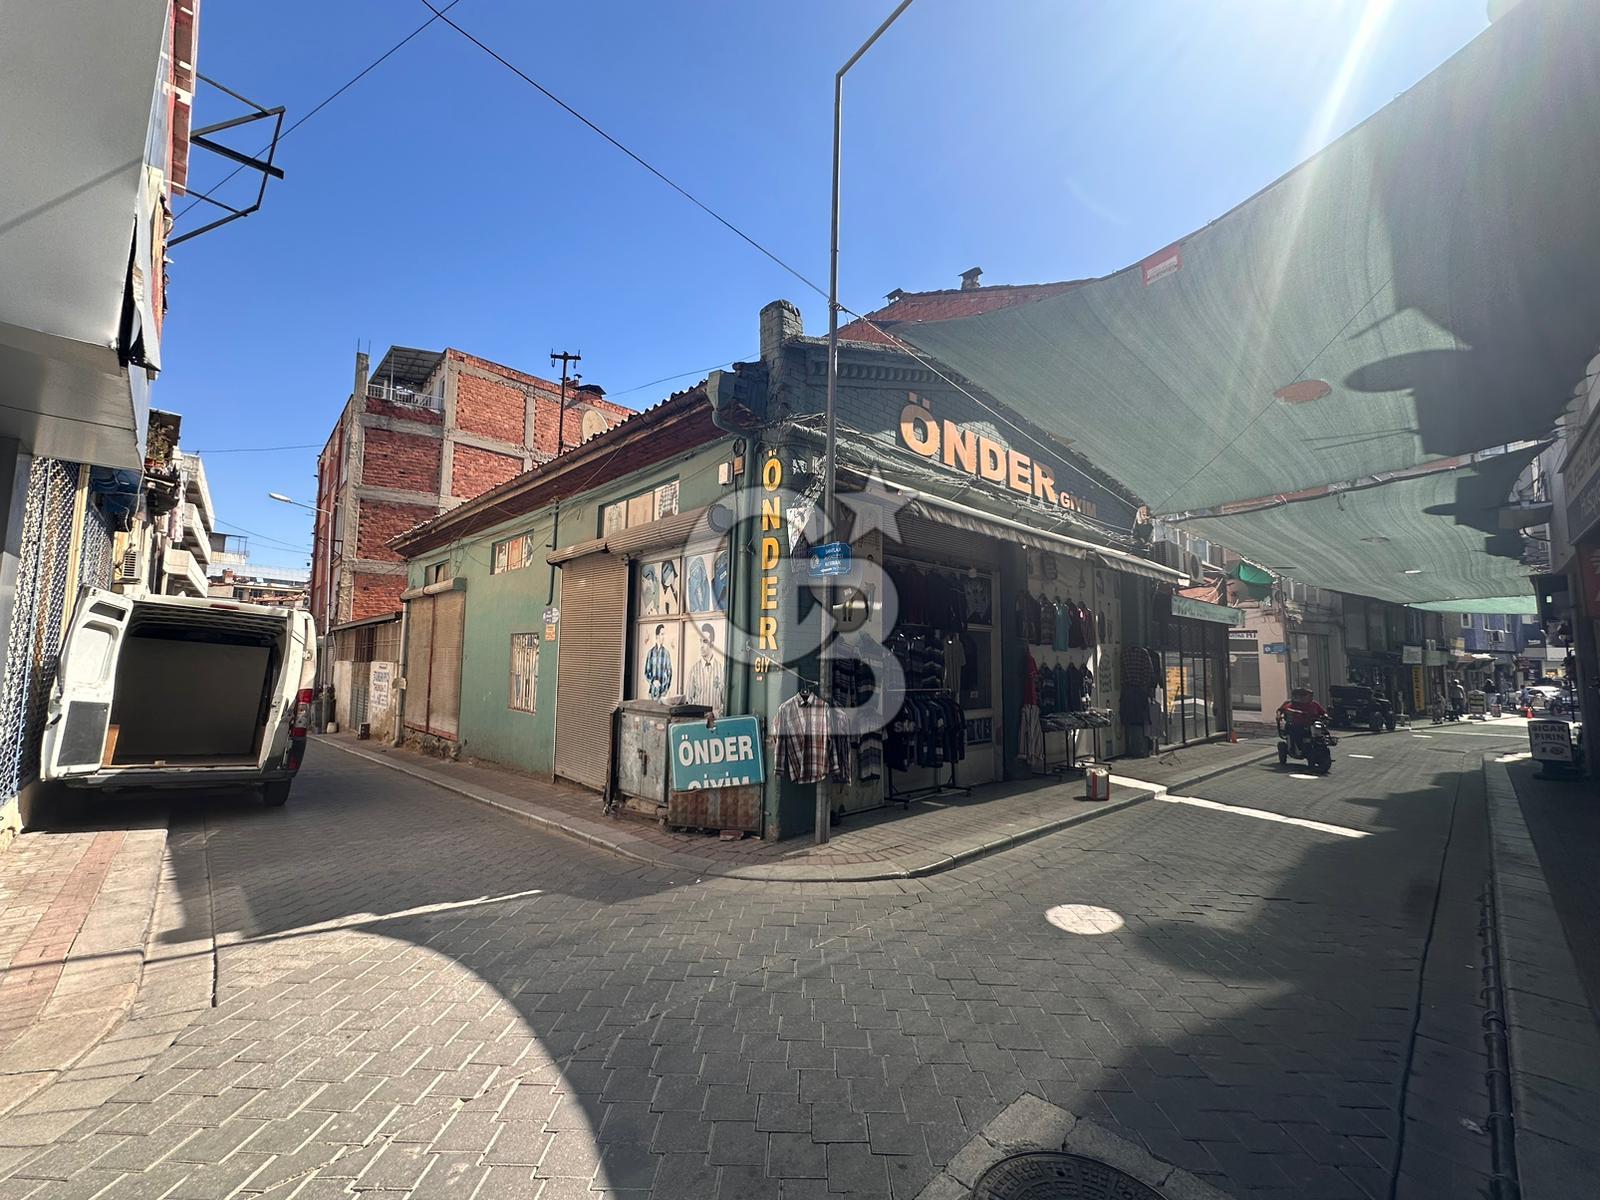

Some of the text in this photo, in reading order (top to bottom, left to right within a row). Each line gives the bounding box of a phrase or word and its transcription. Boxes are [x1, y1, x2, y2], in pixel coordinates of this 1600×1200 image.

[900, 391, 1057, 503] ÖNDER
[759, 448, 782, 651] ÖNDER
[678, 734, 754, 767] ÖNDER
